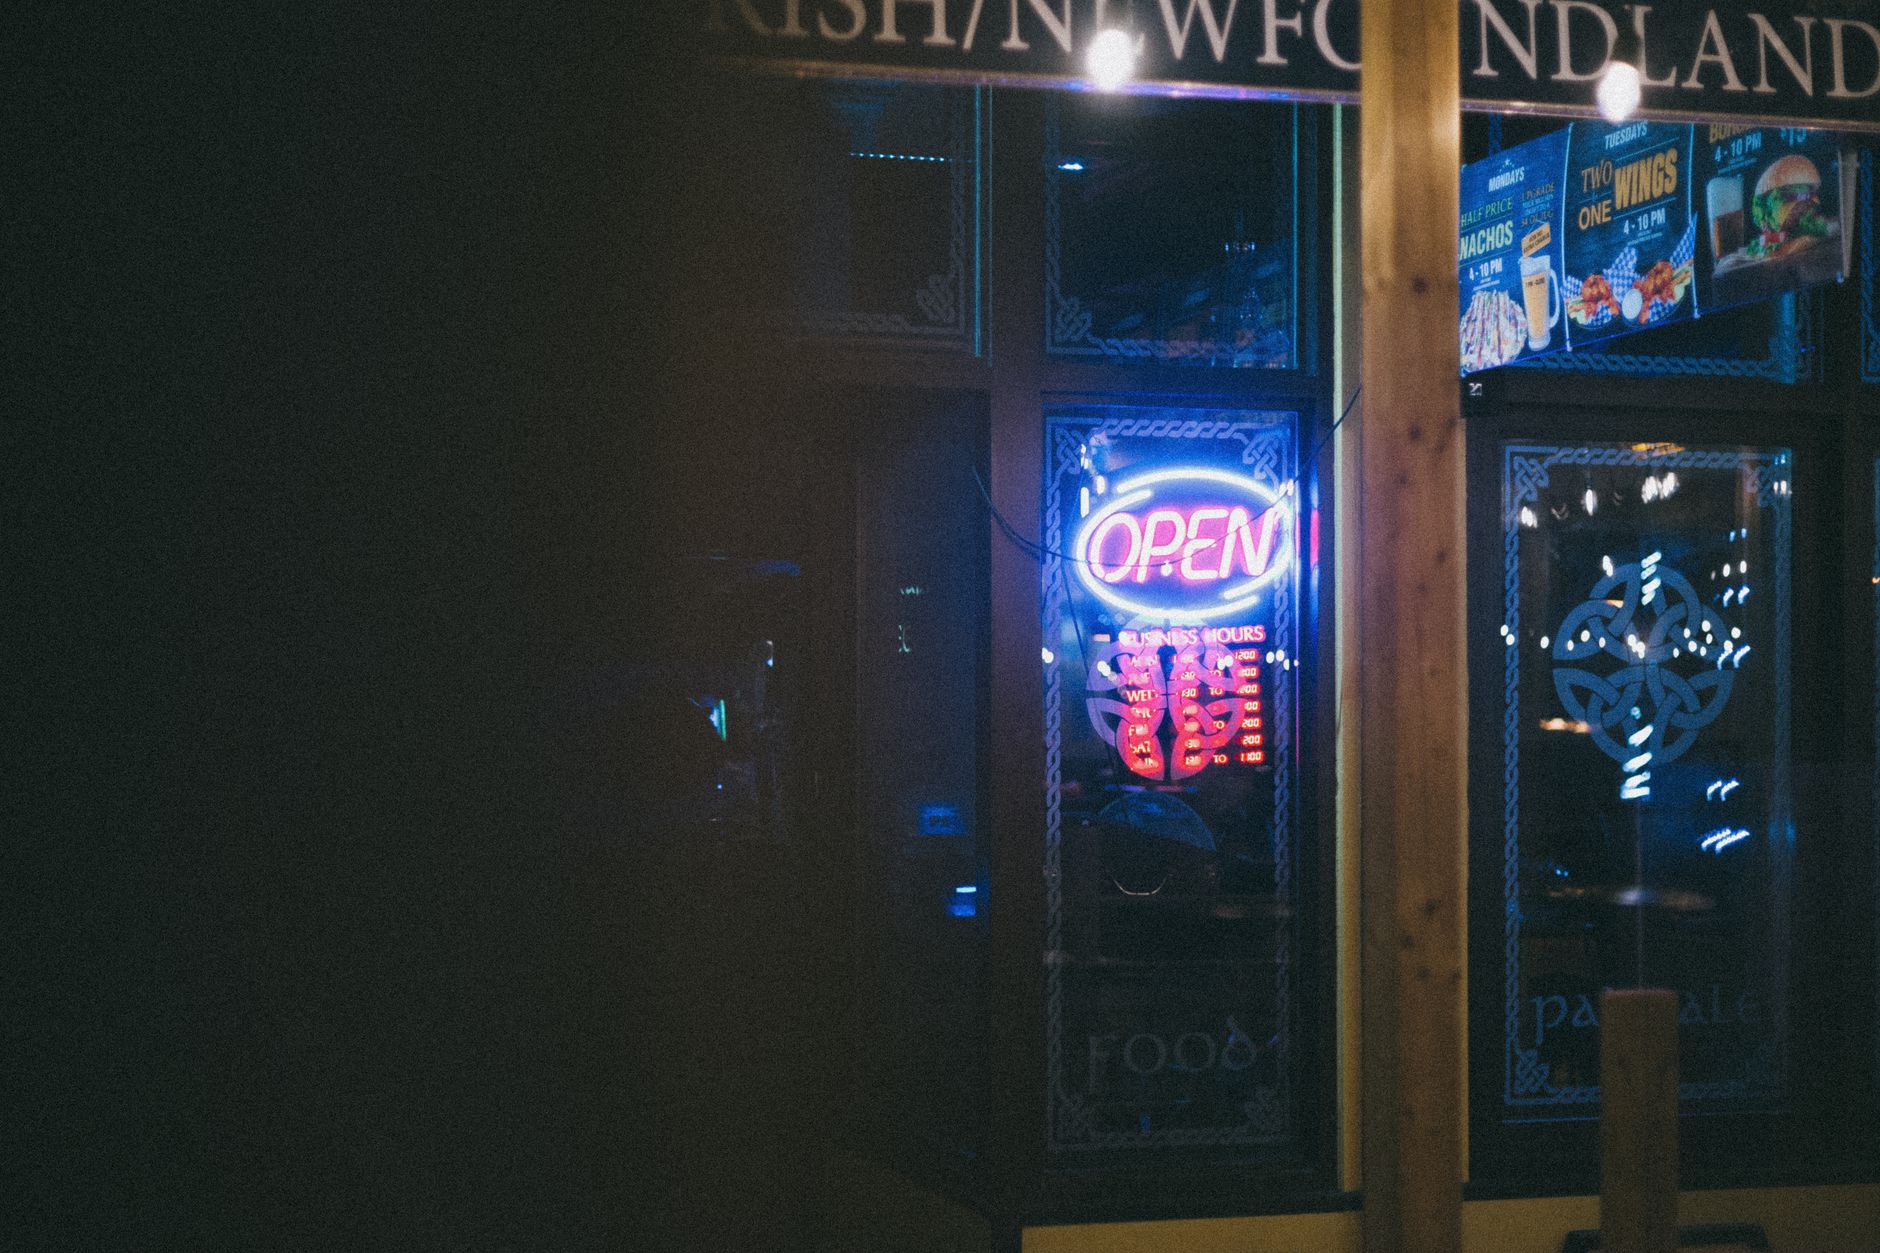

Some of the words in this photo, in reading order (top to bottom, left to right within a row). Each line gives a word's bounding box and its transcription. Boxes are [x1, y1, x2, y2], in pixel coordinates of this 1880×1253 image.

[1605, 120, 1649, 150] TUESDAYS
[1714, 145, 1721, 162] 4
[1731, 139, 1743, 157] 10
[1745, 131, 1762, 152] PM
[1488, 166, 1525, 192] MONDAYS
[1582, 160, 1613, 193] TWO
[1615, 148, 1678, 210] WINGS
[1461, 207, 1483, 227] HALF
[1485, 196, 1513, 218] PRICE
[1578, 200, 1612, 230] ONE
[1623, 220, 1630, 235] 4
[1637, 213, 1649, 231] 10
[1650, 207, 1666, 227] PM
[1459, 220, 1514, 261] NACHOS
[1468, 267, 1475, 281] 4
[1480, 262, 1489, 277] 10
[1490, 258, 1503, 275] PM
[1090, 508, 1277, 583] OPEN
[1209, 687, 1223, 696] TO
[1213, 754, 1227, 764] TO
